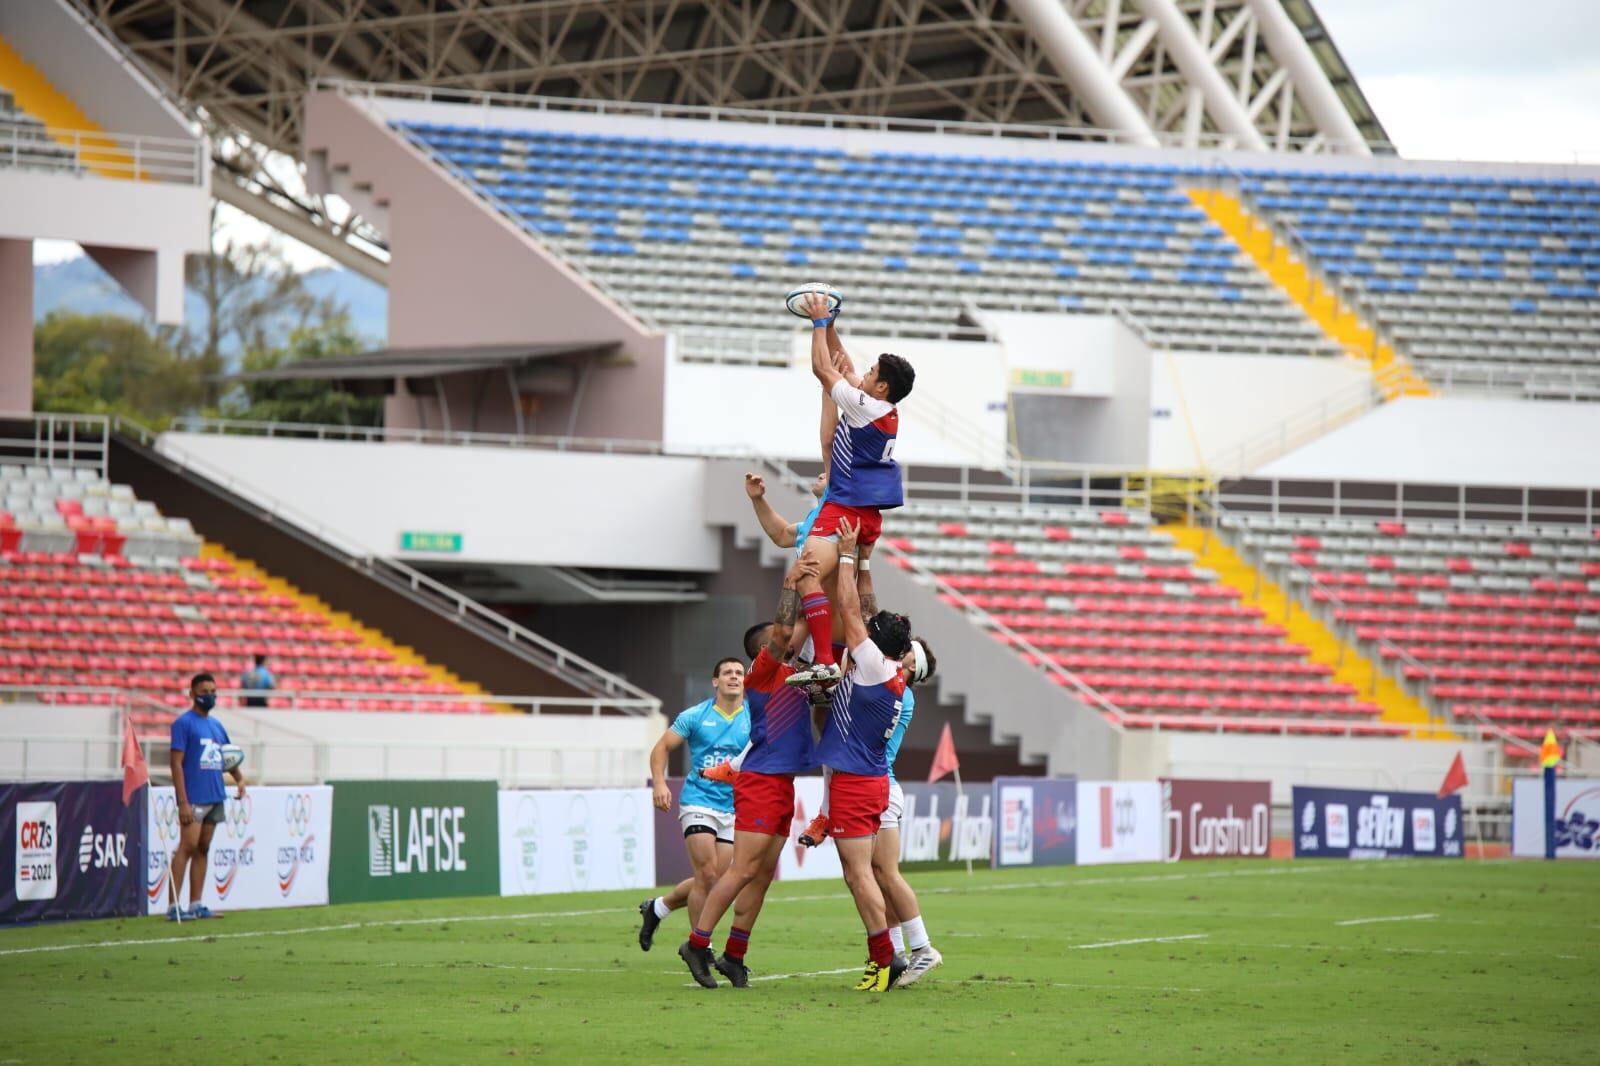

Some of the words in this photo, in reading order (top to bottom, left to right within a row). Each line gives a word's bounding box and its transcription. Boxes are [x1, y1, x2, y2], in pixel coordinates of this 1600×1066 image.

[94, 832, 129, 868] SAR
[392, 806, 467, 873] LAFISE
[214, 849, 237, 867] COSTA
